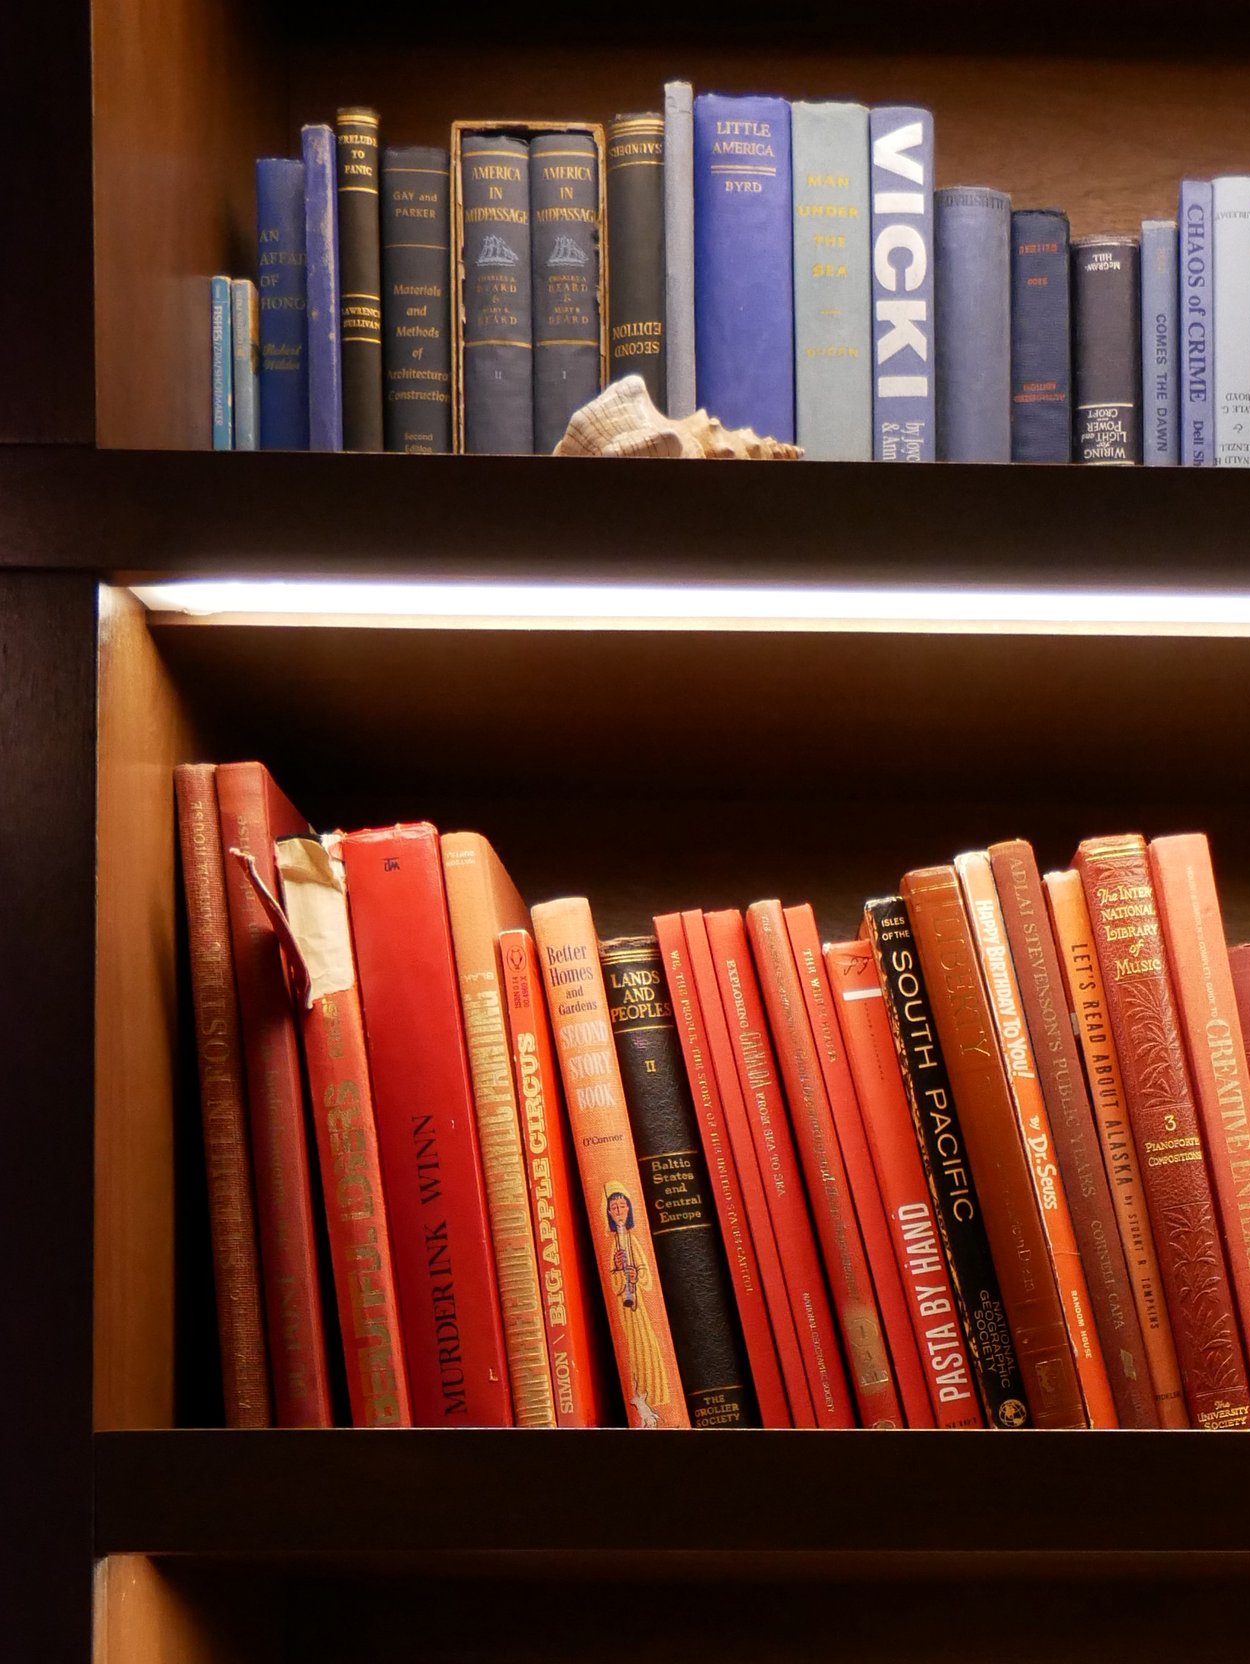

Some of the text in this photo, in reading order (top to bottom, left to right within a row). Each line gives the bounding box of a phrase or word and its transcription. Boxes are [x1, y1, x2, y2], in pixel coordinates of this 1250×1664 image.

[717, 122, 771, 137] LITTLE
[712, 142, 775, 157] AMERICA
[473, 166, 520, 181] AMERICA
[543, 166, 592, 181] AMERICA
[725, 181, 762, 192] BYRD
[393, 192, 437, 202] GAY and
[395, 208, 436, 218] PARKER
[874, 122, 928, 397] VICKI
[407, 306, 427, 316] and
[396, 326, 439, 339] Methods
[1156, 314, 1167, 452] COMES THE DAWN
[1088, 409, 1117, 418] CROFT
[1087, 421, 1121, 431] POWER
[1084, 448, 1125, 458] WIRING
[882, 918, 904, 927] ISLES
[882, 930, 910, 941] OF THE
[546, 945, 586, 965] Better
[550, 967, 593, 987] Homes
[611, 971, 660, 988] LANDS
[566, 987, 584, 998] and
[623, 988, 655, 1003] AND
[976, 900, 1034, 1080] HAPPY BIRTHDAY TO YOU!
[558, 1001, 597, 1015] Gardens
[610, 1002, 671, 1022] PEOPLES
[892, 951, 973, 1222] SOUTH PACIFIC
[652, 1160, 690, 1170] Baltic
[518, 1033, 566, 1326] BIG APPLE CIRCUS
[653, 1172, 694, 1183] States
[665, 1183, 687, 1193] and
[655, 1196, 701, 1209] Central
[660, 1210, 701, 1223] Europe
[412, 1113, 467, 1416] MURDER INK WINN
[898, 1202, 970, 1402] PASTA BY HAND
[1071, 1290, 1092, 1358] RANDOM HOUSE
[555, 1353, 573, 1413] SIMON
